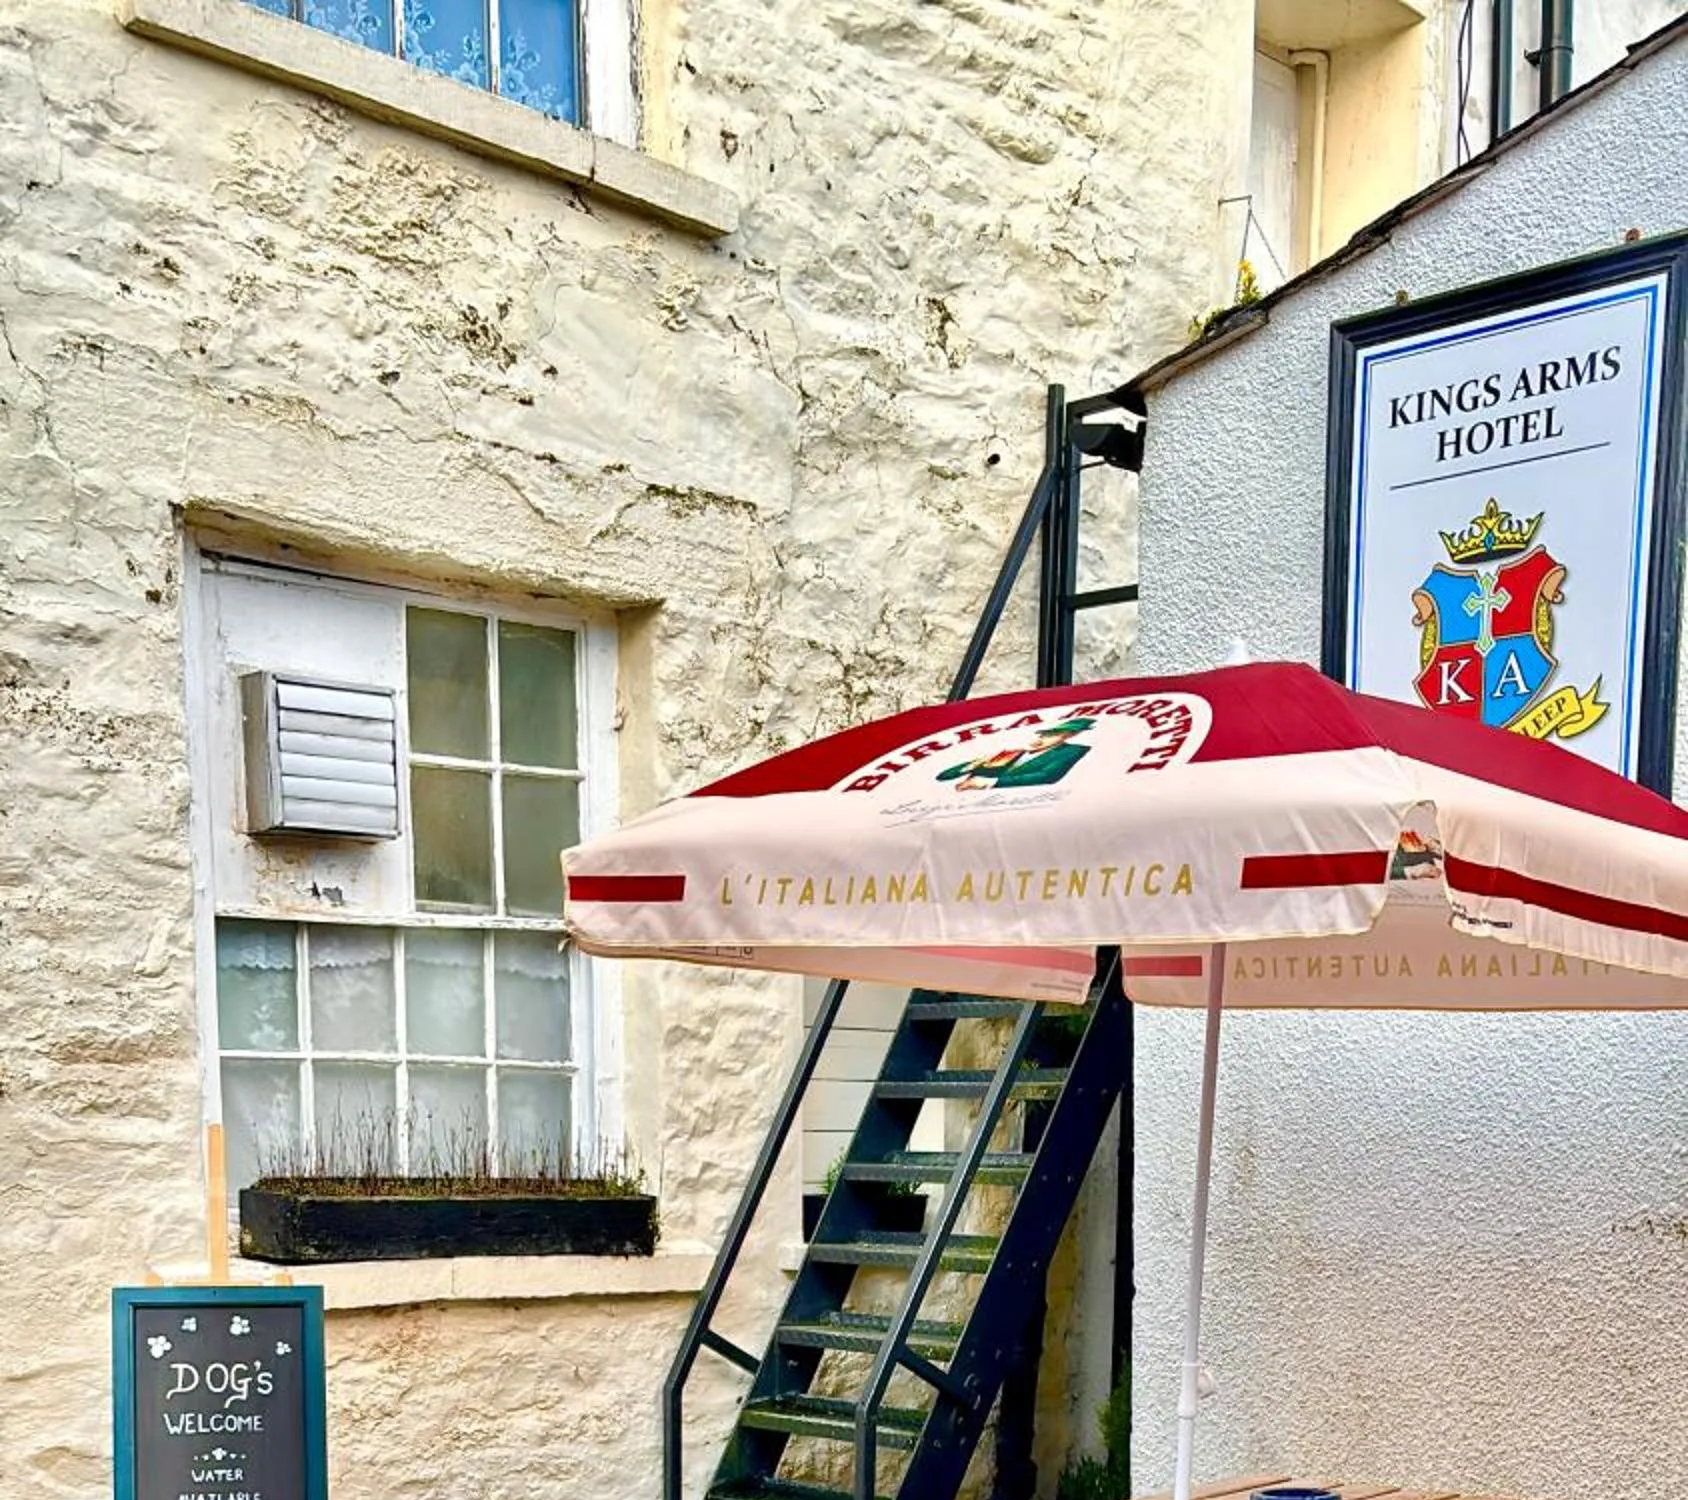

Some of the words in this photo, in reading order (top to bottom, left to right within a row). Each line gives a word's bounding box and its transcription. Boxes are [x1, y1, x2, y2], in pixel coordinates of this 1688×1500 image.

[1389, 373, 1501, 428] KINGS
[1508, 345, 1621, 402] ARMS
[1436, 406, 1564, 462] HOTEL
[1436, 658, 1475, 705] K
[1491, 651, 1531, 698] A
[842, 713, 1044, 793] BIRRA
[1061, 699, 1193, 774] MORETTI
[720, 873, 929, 905] L'ITALIANA
[956, 863, 1195, 902] AUTENTICA
[163, 1413, 264, 1435] WELCOME
[191, 1469, 244, 1482] WATER
